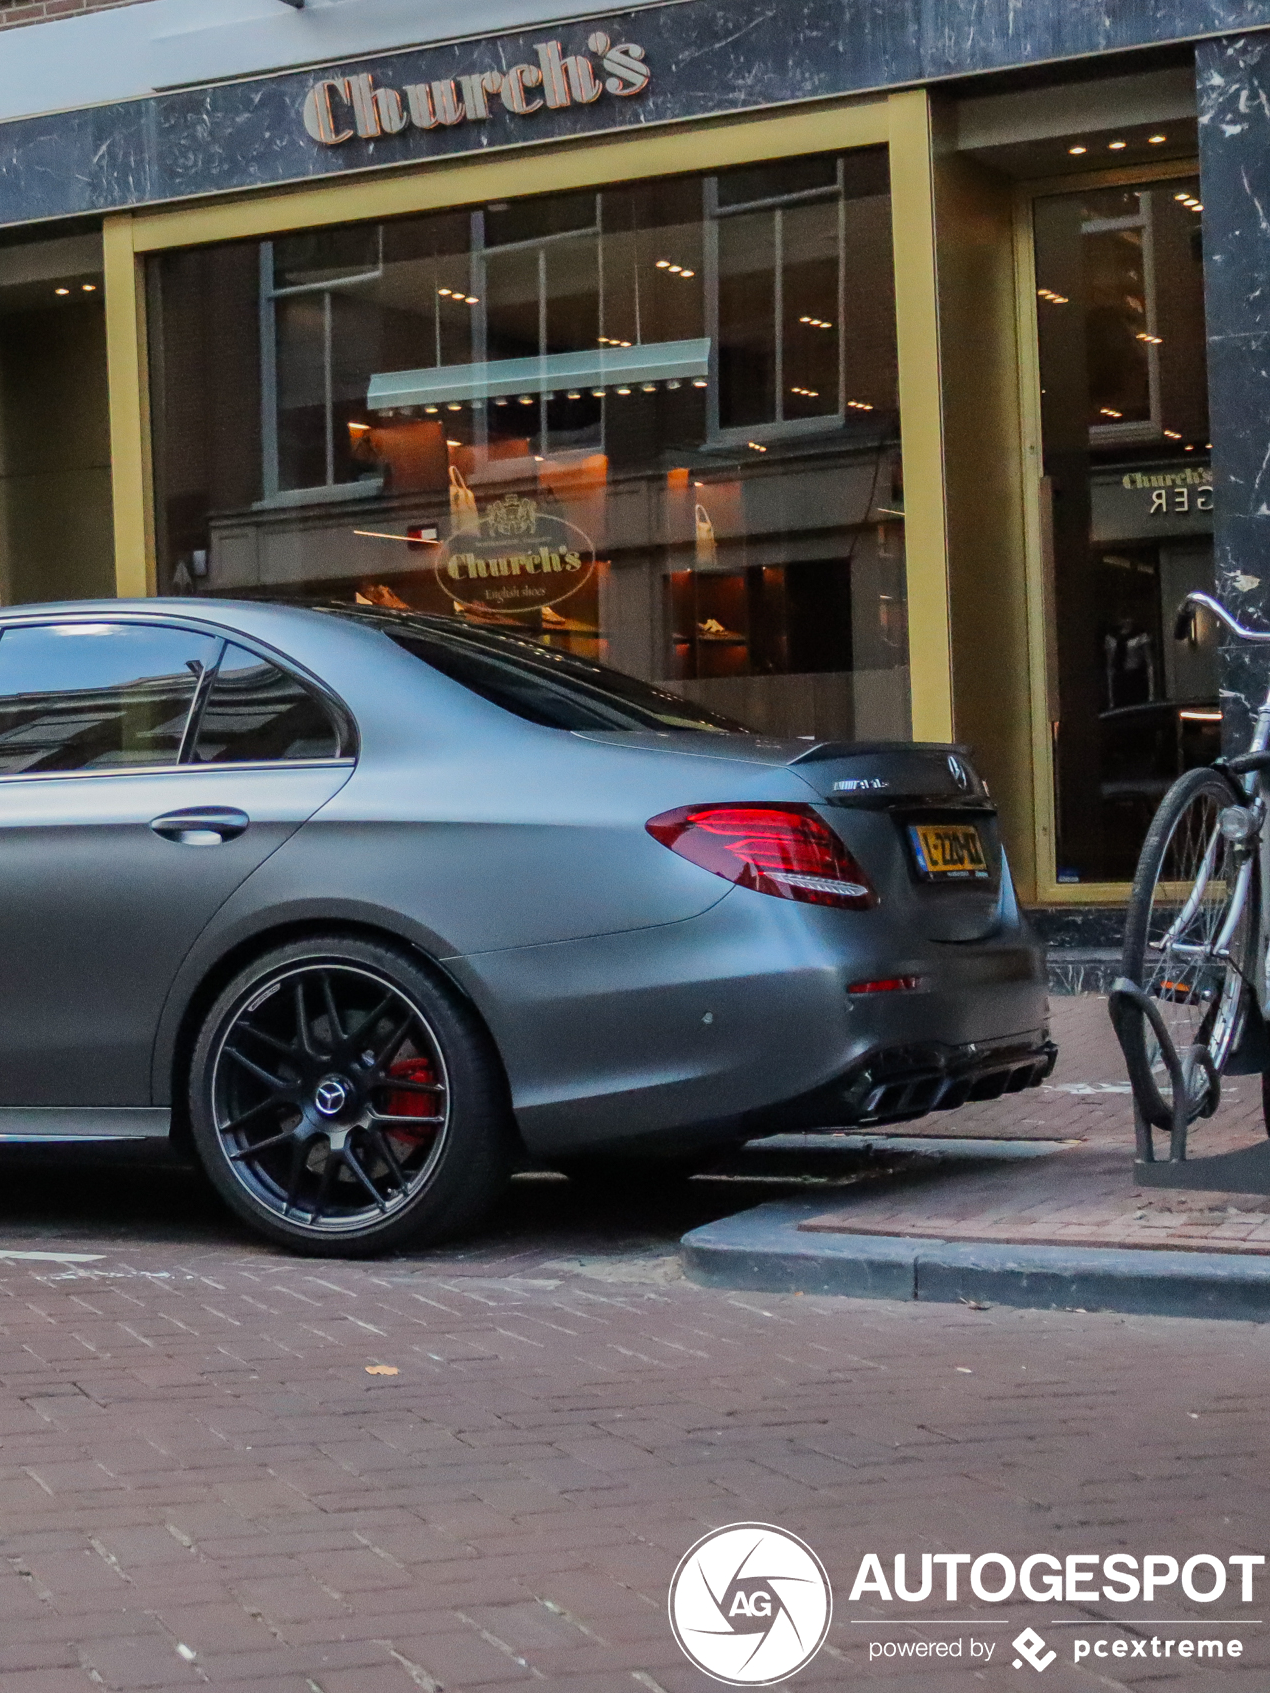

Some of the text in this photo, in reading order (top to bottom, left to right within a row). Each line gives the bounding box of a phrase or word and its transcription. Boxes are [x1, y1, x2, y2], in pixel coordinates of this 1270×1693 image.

[303, 31, 650, 144] Church's
[1122, 467, 1213, 490] Church's
[447, 545, 582, 580] Church's
[485, 584, 547, 604] English shoes
